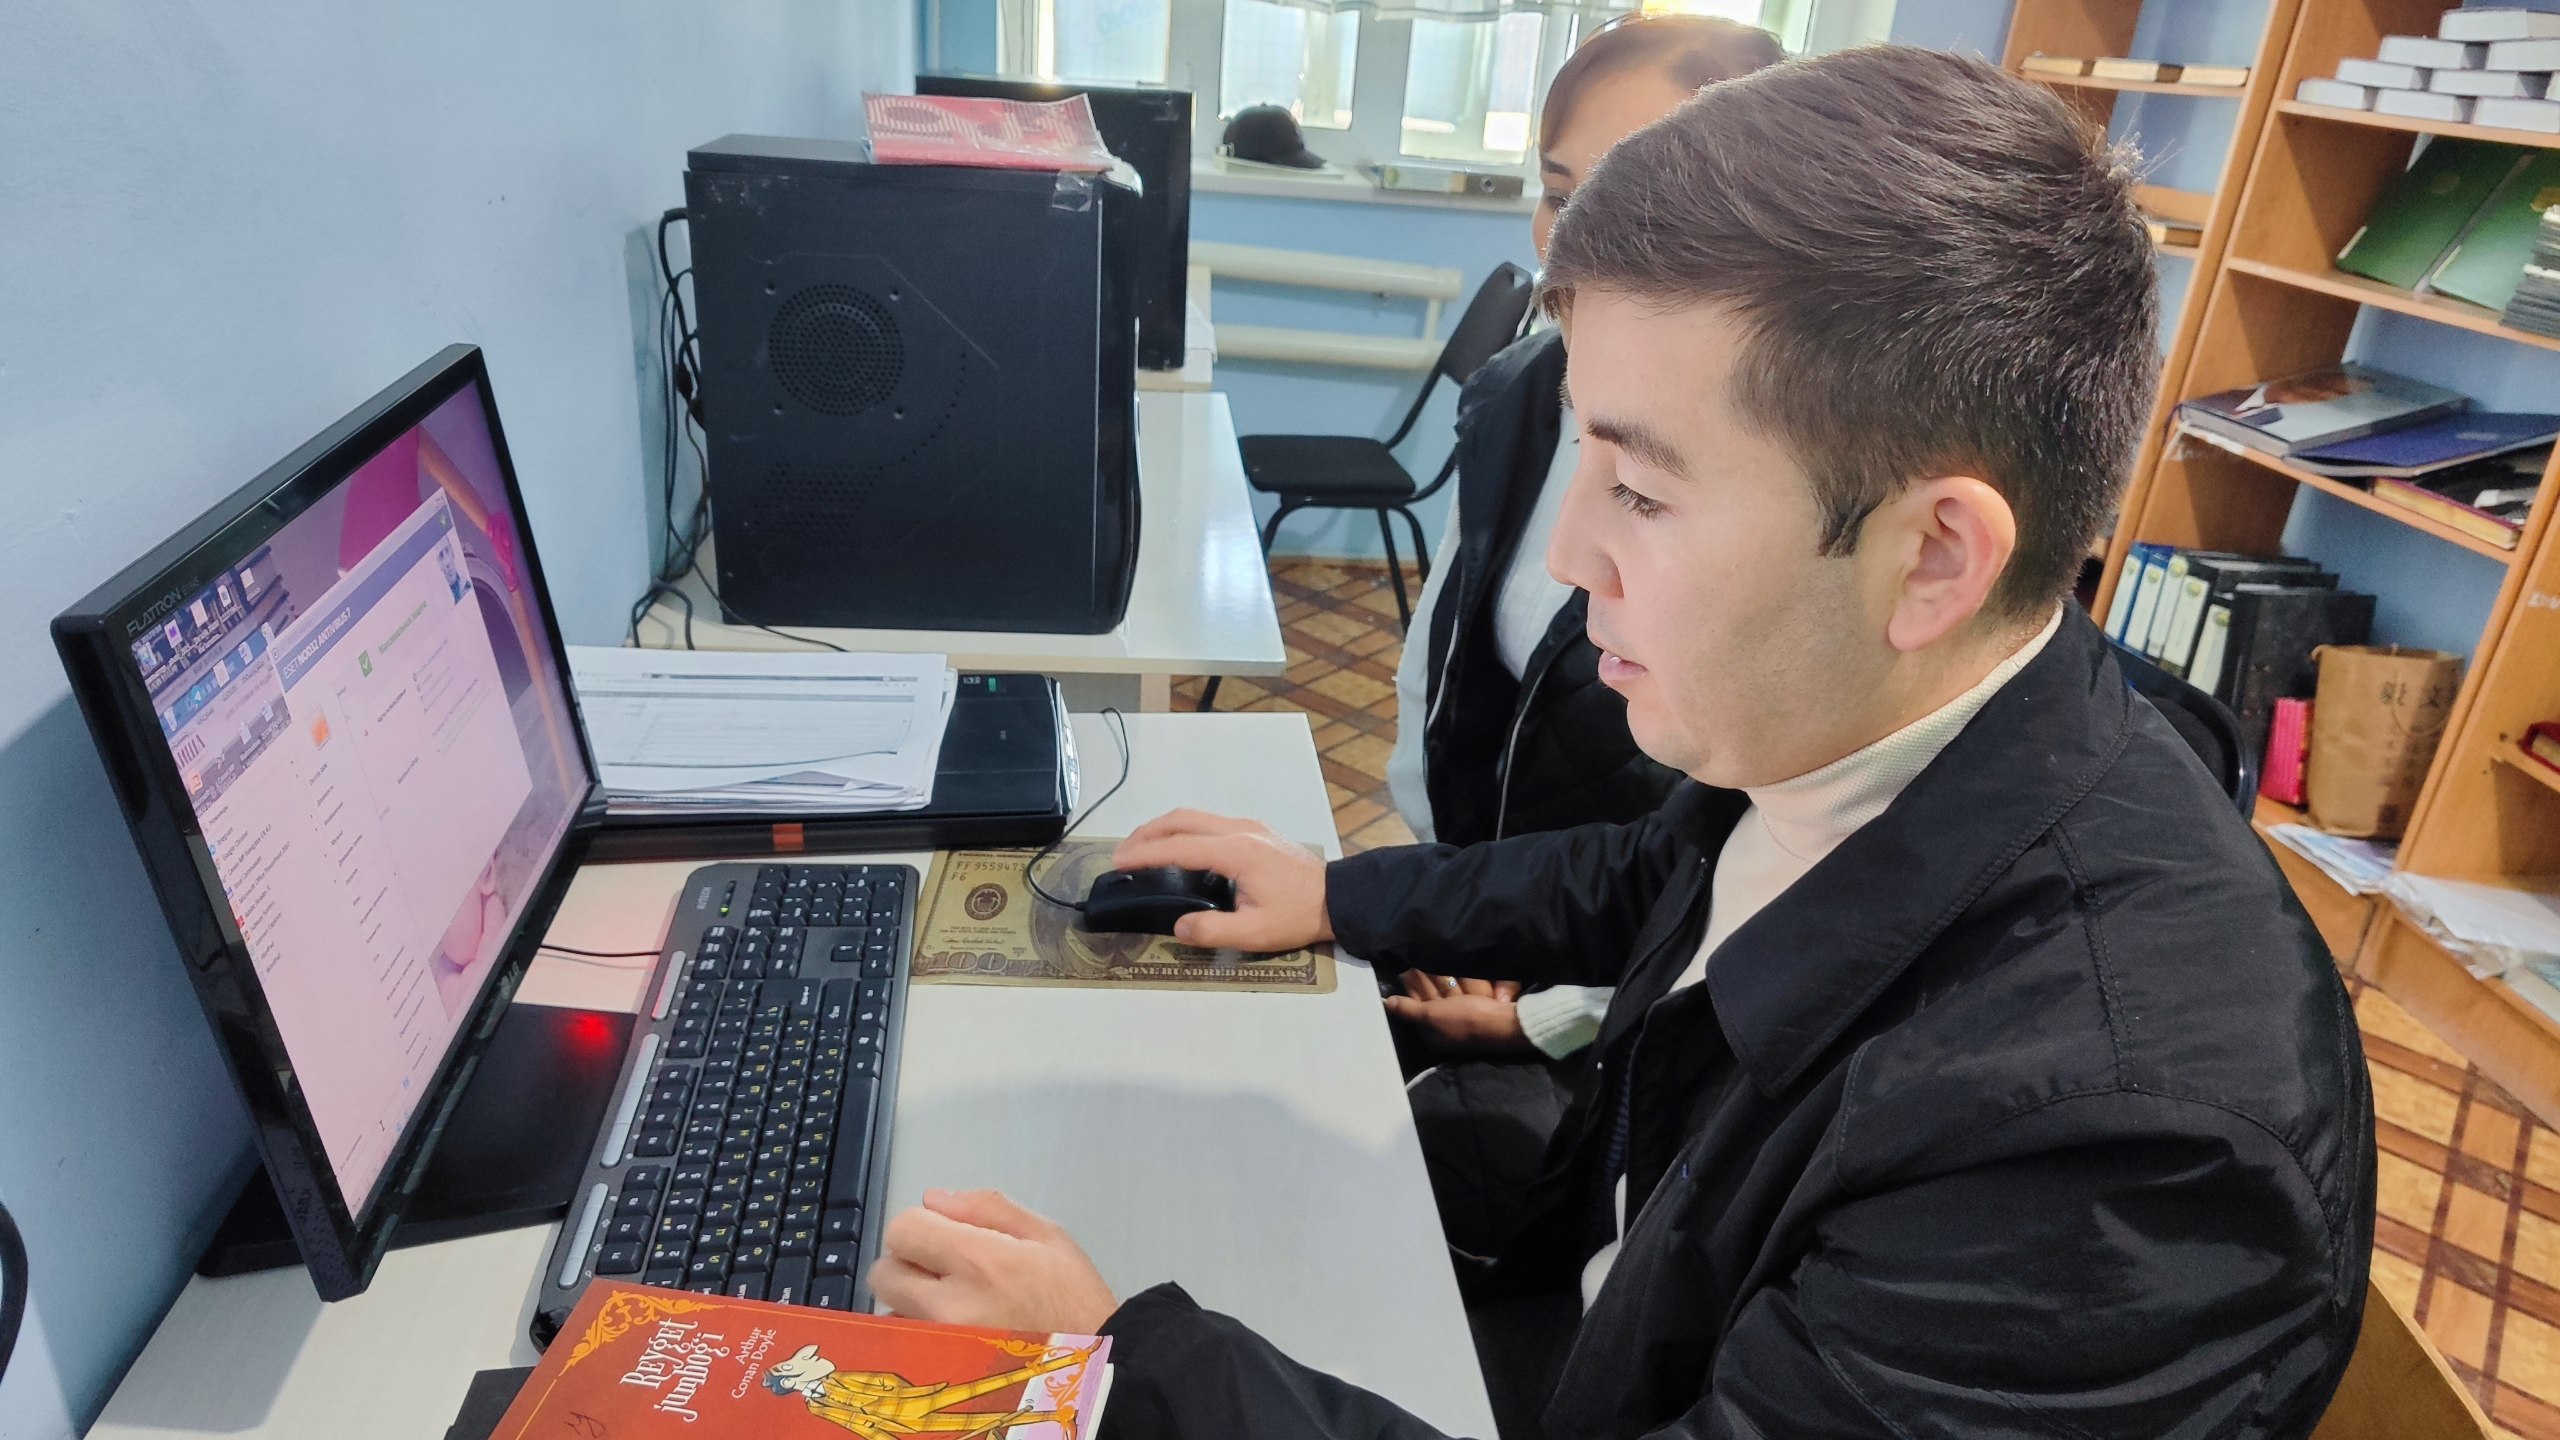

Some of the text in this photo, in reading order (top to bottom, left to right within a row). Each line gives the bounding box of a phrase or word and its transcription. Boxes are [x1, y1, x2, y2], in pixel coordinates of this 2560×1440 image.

[126, 588, 181, 637] FLATRON
[283, 659, 299, 678] ESET
[316, 611, 347, 645] ANTIVIRUS
[1129, 966, 1308, 978] ONE HUNDRED DOLLARS
[731, 1329, 777, 1399] Conan Doyle
[735, 1327, 762, 1365] Arthur
